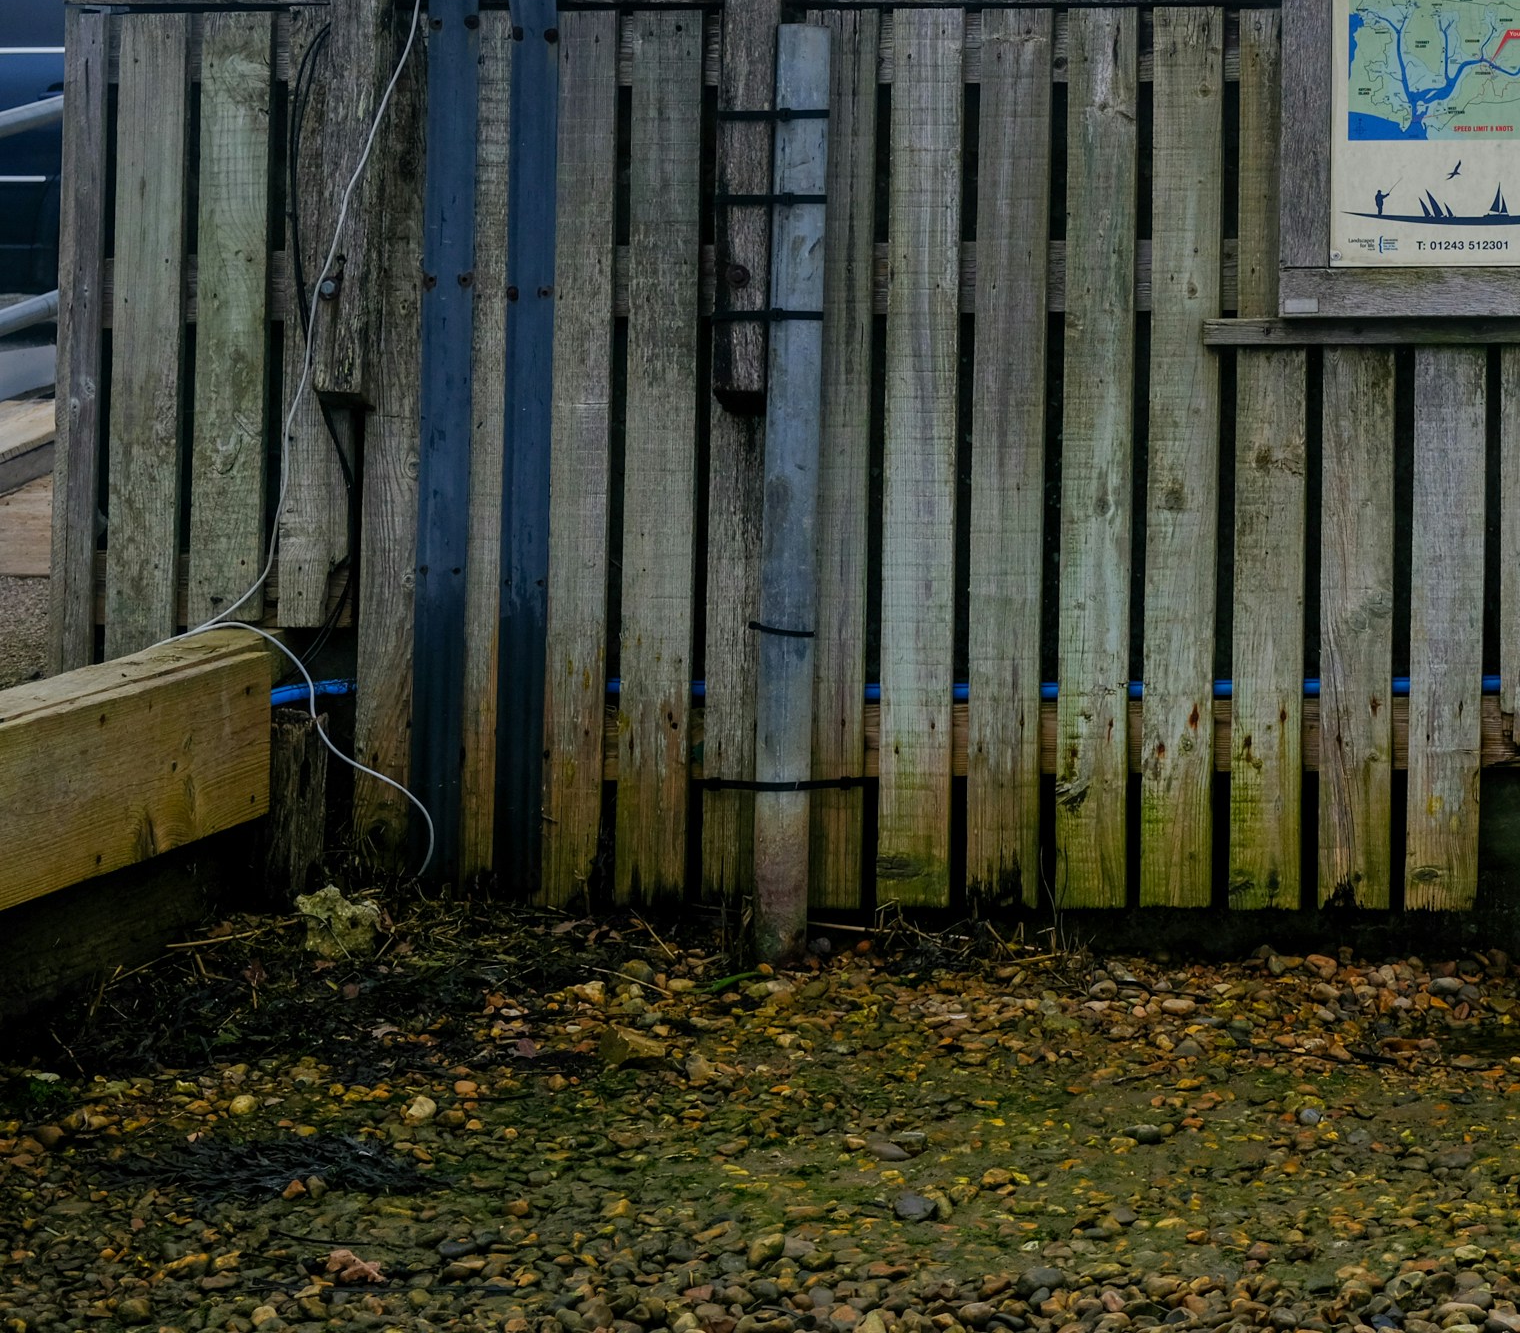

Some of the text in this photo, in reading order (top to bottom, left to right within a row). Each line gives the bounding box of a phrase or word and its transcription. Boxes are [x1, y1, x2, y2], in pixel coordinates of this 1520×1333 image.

[1416, 241, 1508, 250] T: 01243 512301
